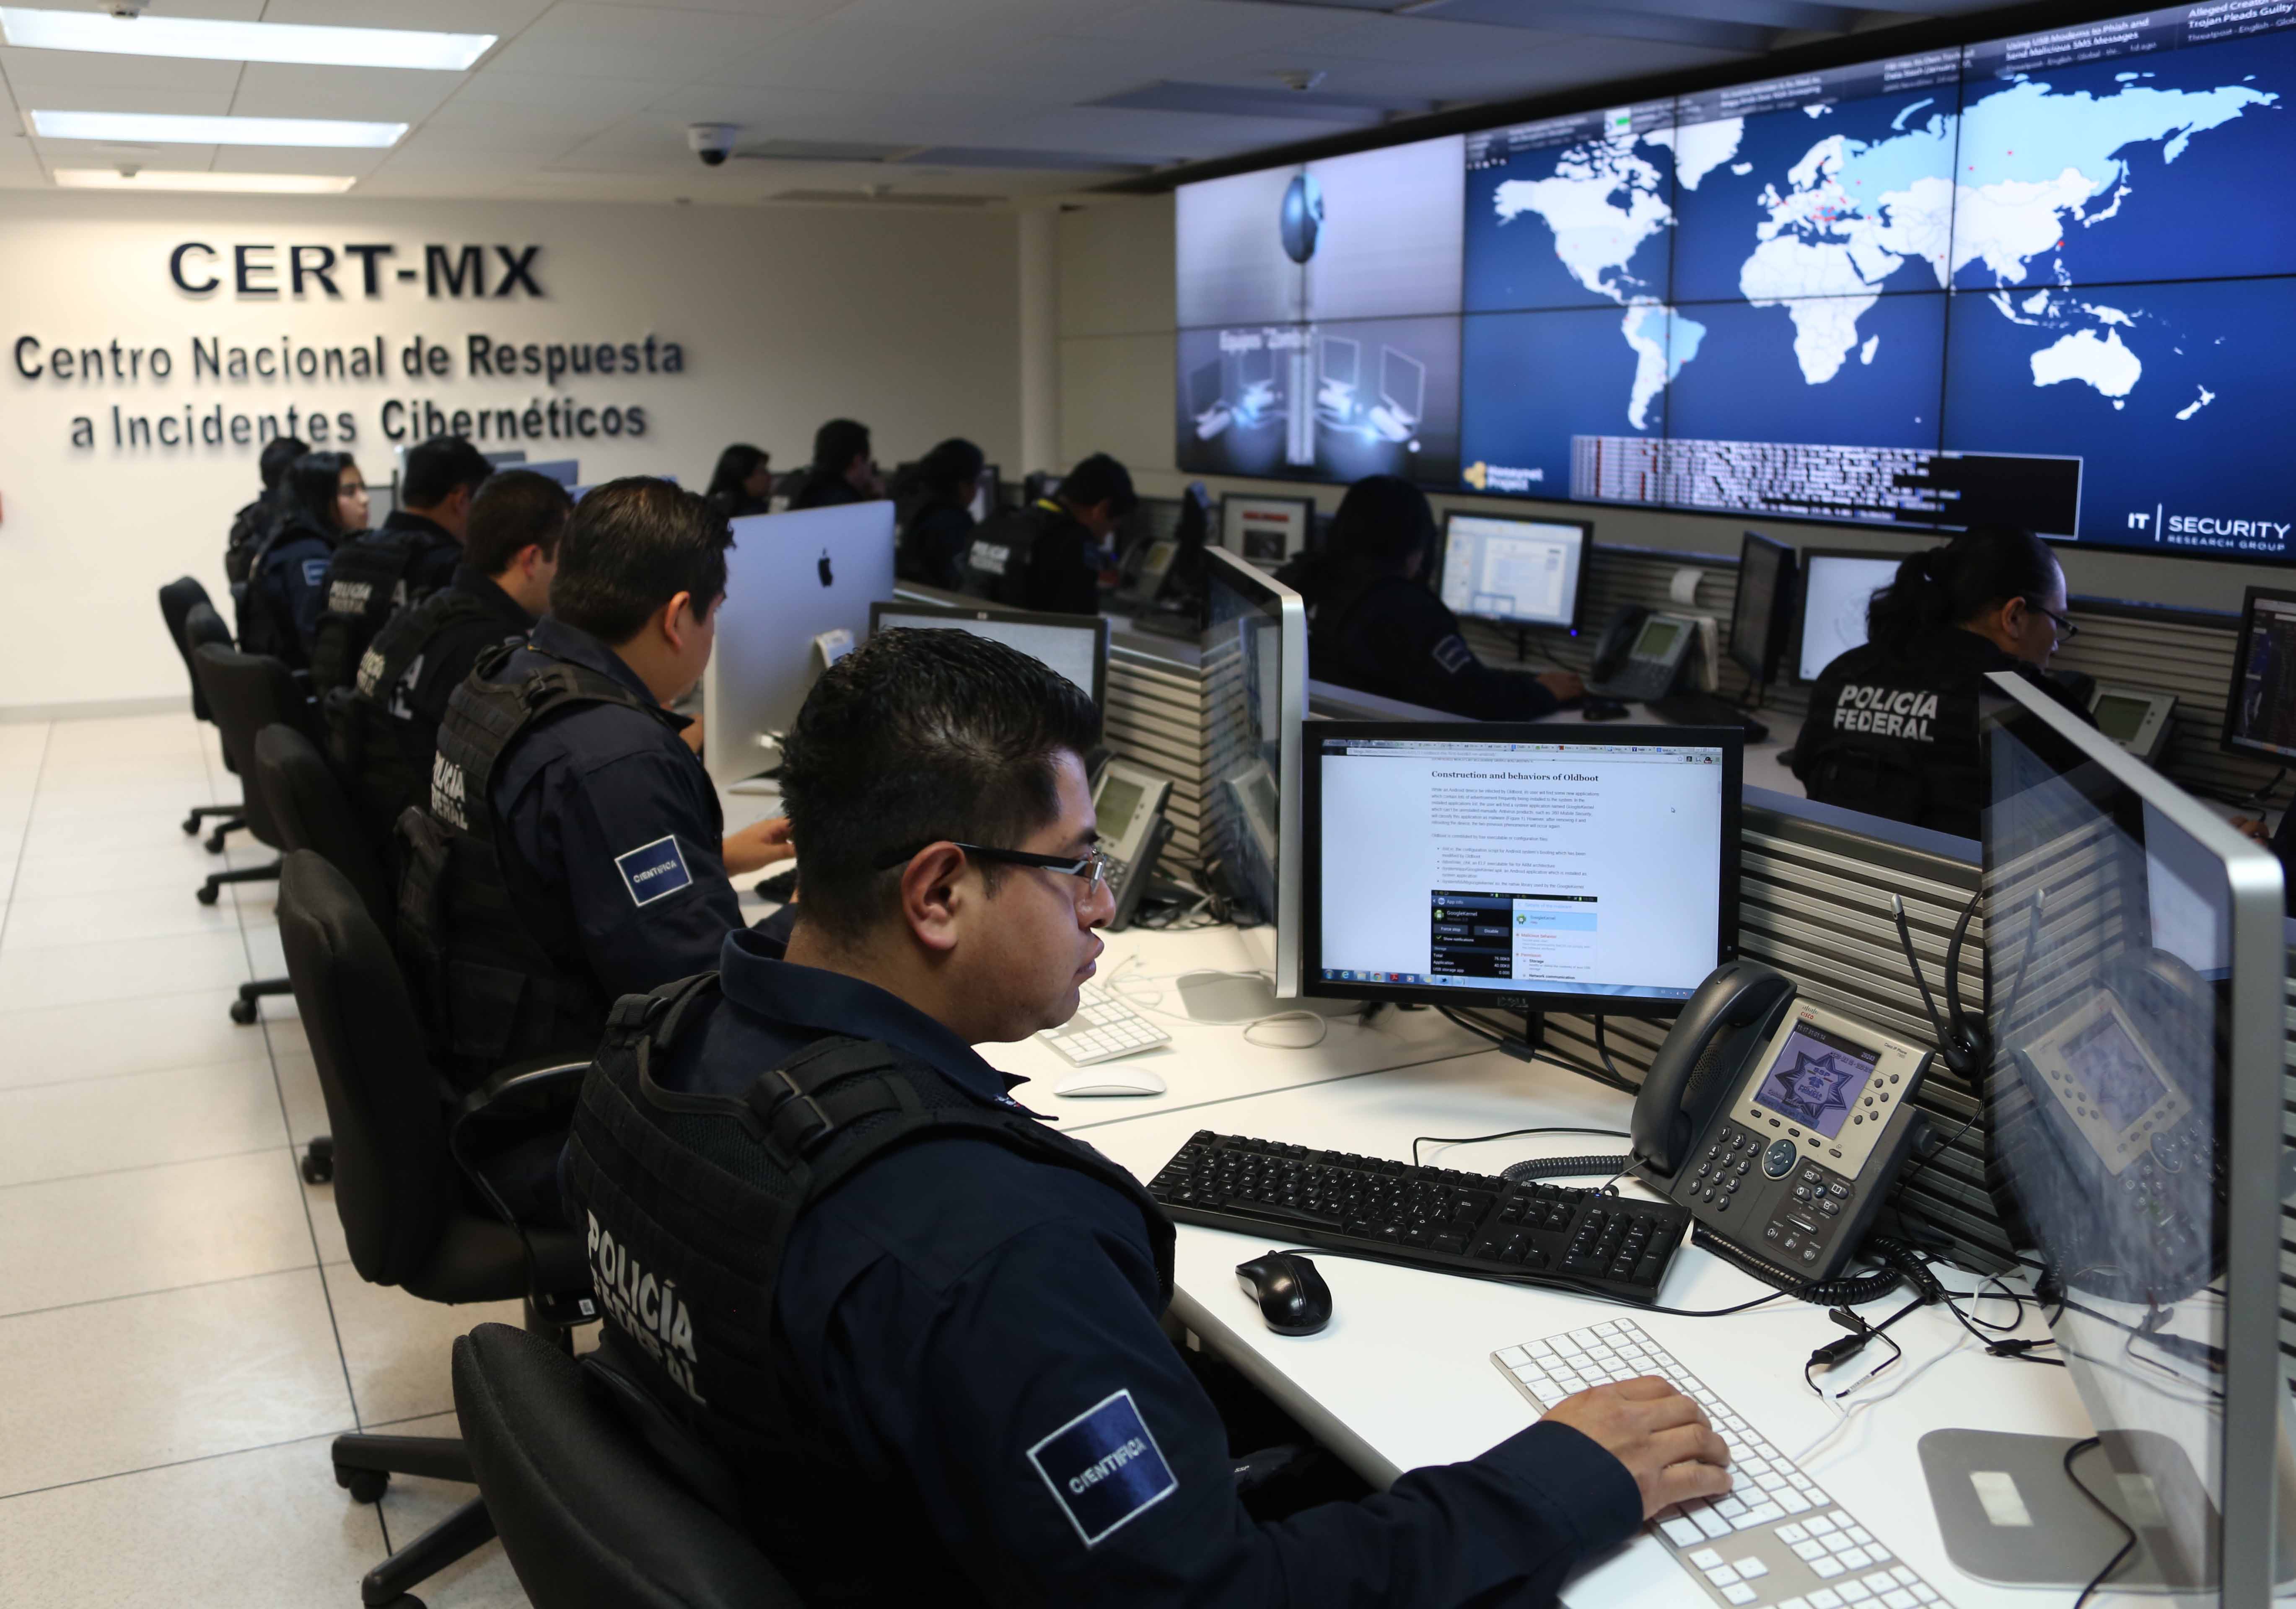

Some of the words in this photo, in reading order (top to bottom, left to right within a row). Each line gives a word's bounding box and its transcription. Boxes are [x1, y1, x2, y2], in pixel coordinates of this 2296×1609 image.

[2260, 3, 2293, 17] Guilty
[170, 242, 546, 297] CERT-MX
[15, 335, 172, 379] Centro
[193, 335, 385, 378] Nacional
[402, 335, 450, 377] de
[467, 334, 684, 384] Respuesta
[72, 416, 94, 447] a
[114, 404, 357, 446] Incidentes
[381, 398, 647, 442] Cibernéticos
[2128, 512, 2150, 529] IT
[2168, 515, 2291, 539] SECURITY
[2167, 534, 2234, 548] RESEARCH
[2239, 540, 2286, 551] GROUP
[1838, 685, 1938, 719] POLICÍA
[1833, 708, 1934, 742] FEDERAL
[633, 859, 677, 884] CIENTIFICA
[587, 1208, 697, 1363] POLICÍA
[1068, 1437, 1147, 1495] CIENTIFICA
